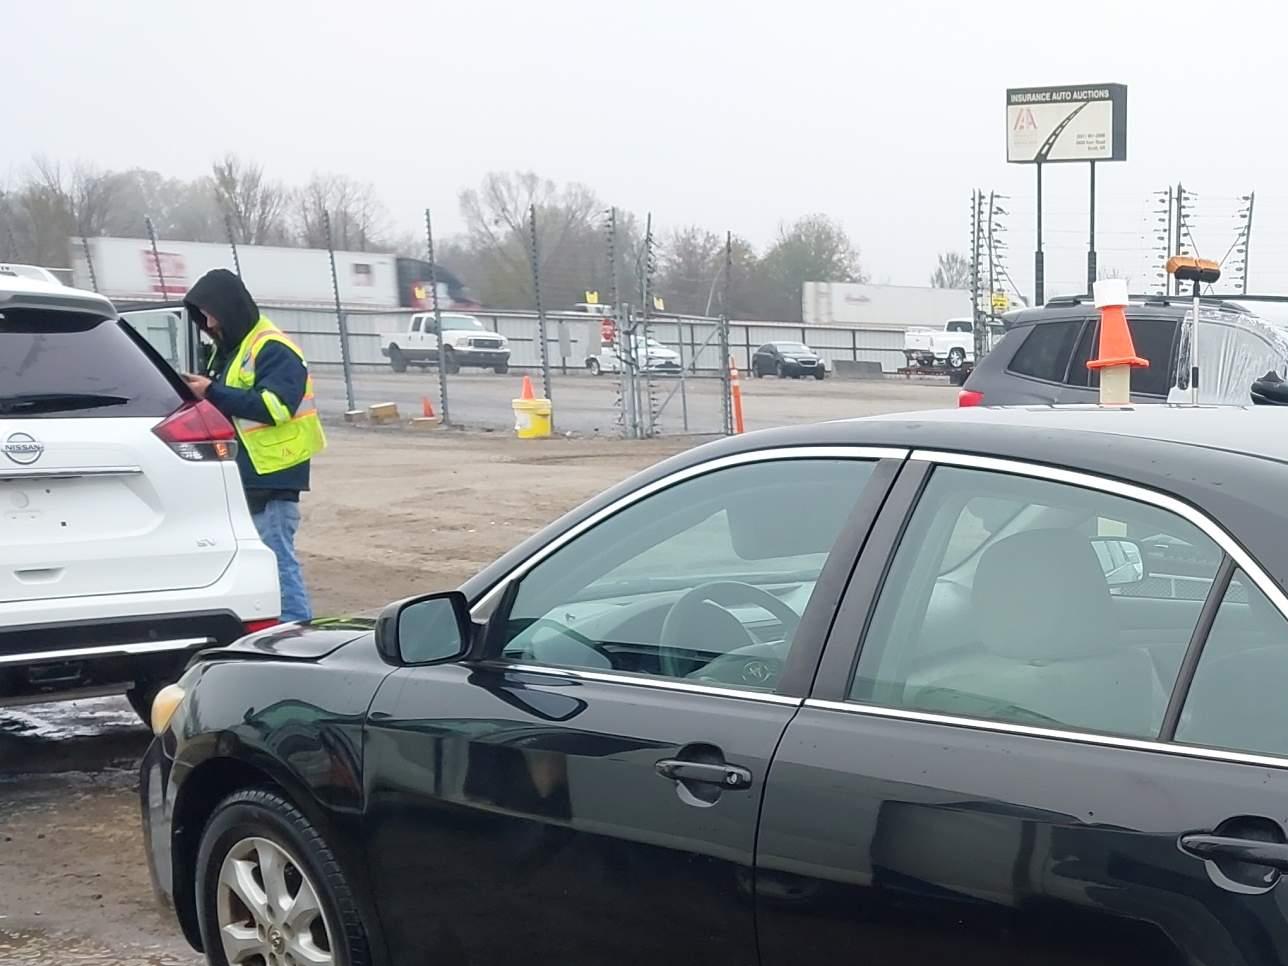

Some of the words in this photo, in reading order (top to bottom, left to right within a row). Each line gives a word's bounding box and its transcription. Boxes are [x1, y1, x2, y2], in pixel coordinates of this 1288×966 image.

[1010, 92, 1051, 103] INSURANCE
[1052, 91, 1072, 101] AUTO
[1073, 89, 1110, 100] AUCTIONS
